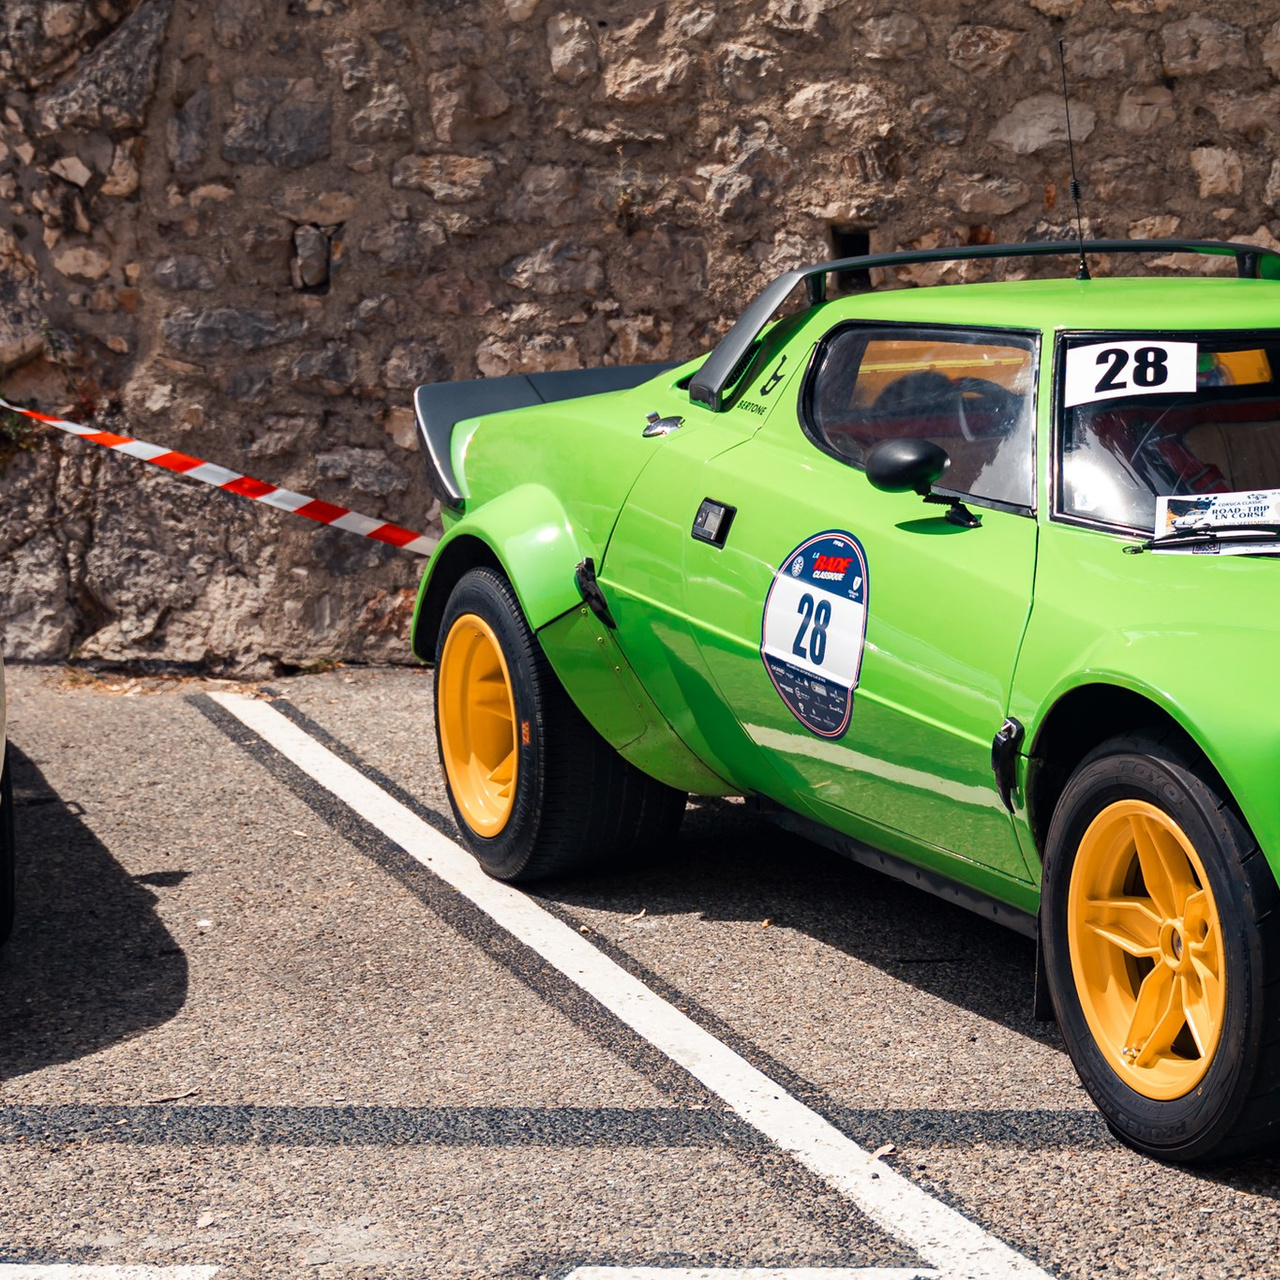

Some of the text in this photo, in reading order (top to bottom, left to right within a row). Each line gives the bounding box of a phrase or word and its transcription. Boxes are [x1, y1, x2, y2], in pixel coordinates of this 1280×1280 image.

[1095, 347, 1168, 393] 28
[737, 400, 767, 415] BERTONE
[1231, 511, 1266, 519] CORSE
[813, 555, 853, 573] RADE
[812, 571, 845, 581] CLASSIQUE
[792, 593, 832, 665] 28
[1117, 759, 1186, 805] TOYO
